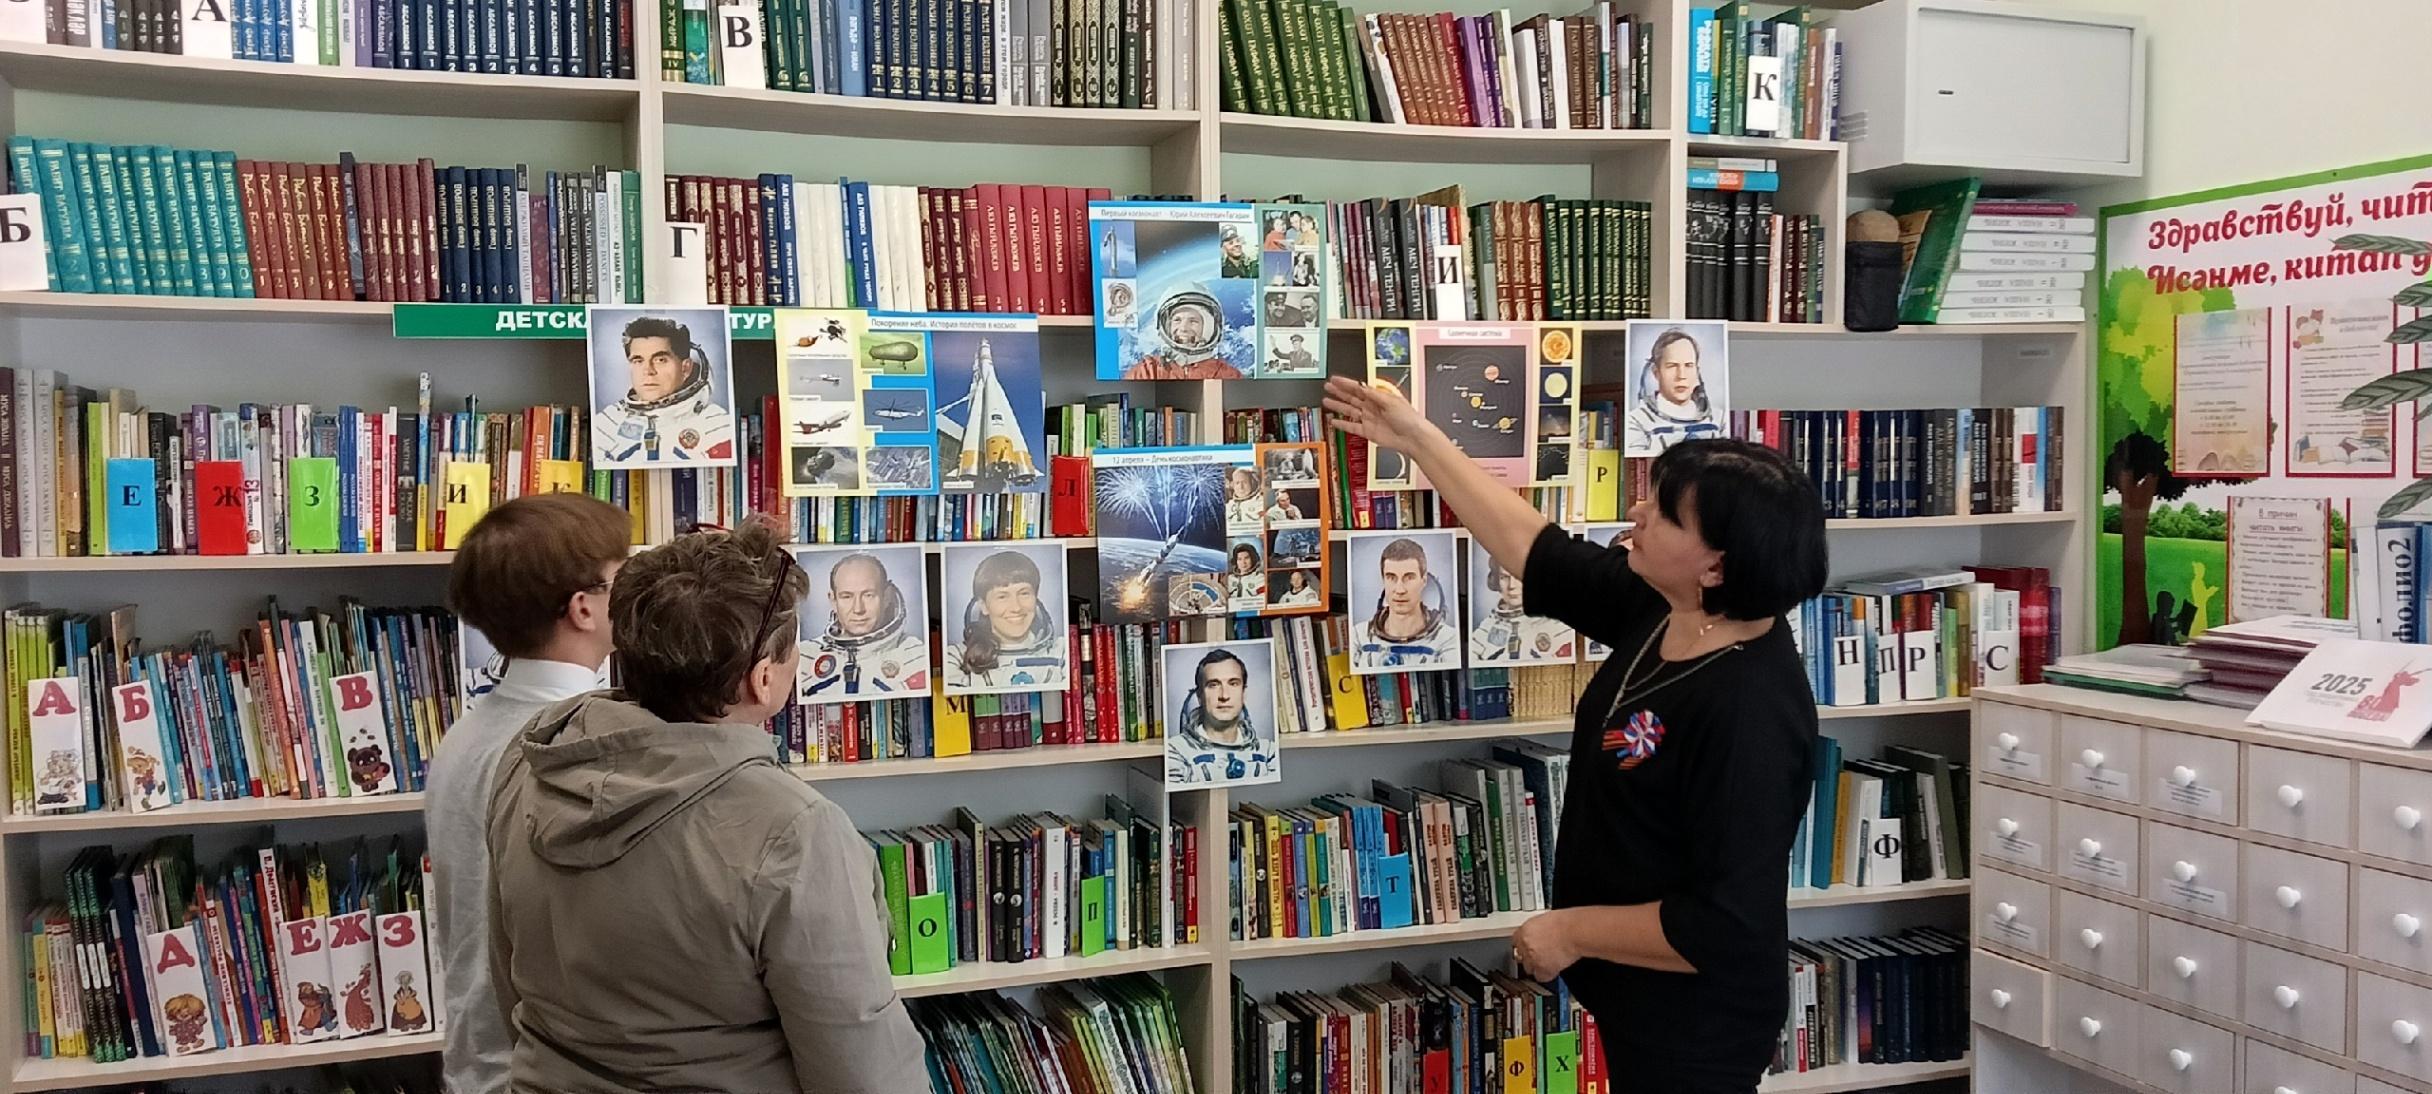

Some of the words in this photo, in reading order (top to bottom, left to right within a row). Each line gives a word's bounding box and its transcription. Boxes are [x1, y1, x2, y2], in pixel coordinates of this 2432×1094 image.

[725, 16, 753, 48] В
[403, 58, 410, 68] 1
[429, 58, 435, 68] 1
[448, 62, 456, 73] 2
[468, 62, 477, 73] 3
[489, 61, 497, 72] 2
[509, 64, 517, 75] 5
[529, 62, 537, 73] 4
[551, 64, 560, 75] 5
[571, 64, 579, 75] 4
[876, 78, 882, 87] 1
[893, 78, 901, 88] 2
[911, 79, 918, 89] 3
[930, 82, 938, 91] 4
[946, 83, 955, 92] 5
[965, 84, 973, 94] 6
[983, 85, 991, 95] 7
[1753, 73, 1777, 101] К
[0, 207, 31, 243] Б
[2148, 192, 2353, 253] Здравствуй,
[2362, 181, 2432, 221] чит
[670, 226, 697, 258] Г
[1381, 246, 1392, 269] МЕЧ
[1408, 246, 1418, 269] МЕЧ
[1436, 256, 1458, 284] И
[2147, 260, 2278, 295] Исәнме,
[2284, 250, 2403, 281] китап
[1384, 272, 1396, 313] ТЕНГРИ
[1411, 273, 1422, 313] ТЕНГРИ
[496, 311, 590, 331] ДЕТСК
[930, 319, 958, 329] История
[1121, 457, 1144, 465] апреля
[1597, 466, 1608, 482] Р
[121, 485, 142, 507] Е
[213, 485, 243, 507] Ж
[244, 479, 260, 495] 13
[304, 485, 320, 507] З
[449, 483, 467, 504] И
[1058, 478, 1075, 497] Л
[1836, 639, 1860, 666] Н
[1878, 647, 1898, 673] П
[1906, 647, 1925, 672] Р
[1986, 645, 2009, 671] С
[335, 676, 374, 711] В
[1338, 676, 1354, 694] С
[2309, 672, 2374, 696] 2025
[32, 680, 77, 717] А
[119, 685, 150, 722] Б
[946, 696, 966, 715] М
[1874, 833, 1900, 859] Ф
[1386, 875, 1400, 894] Т
[1088, 902, 1098, 922] П
[286, 919, 322, 956] Е
[329, 914, 371, 949] Ж
[382, 915, 416, 948] З
[918, 917, 937, 938] О
[157, 933, 195, 975] Д
[1508, 1060, 1525, 1078] Ф
[1555, 1054, 1570, 1074] Х
